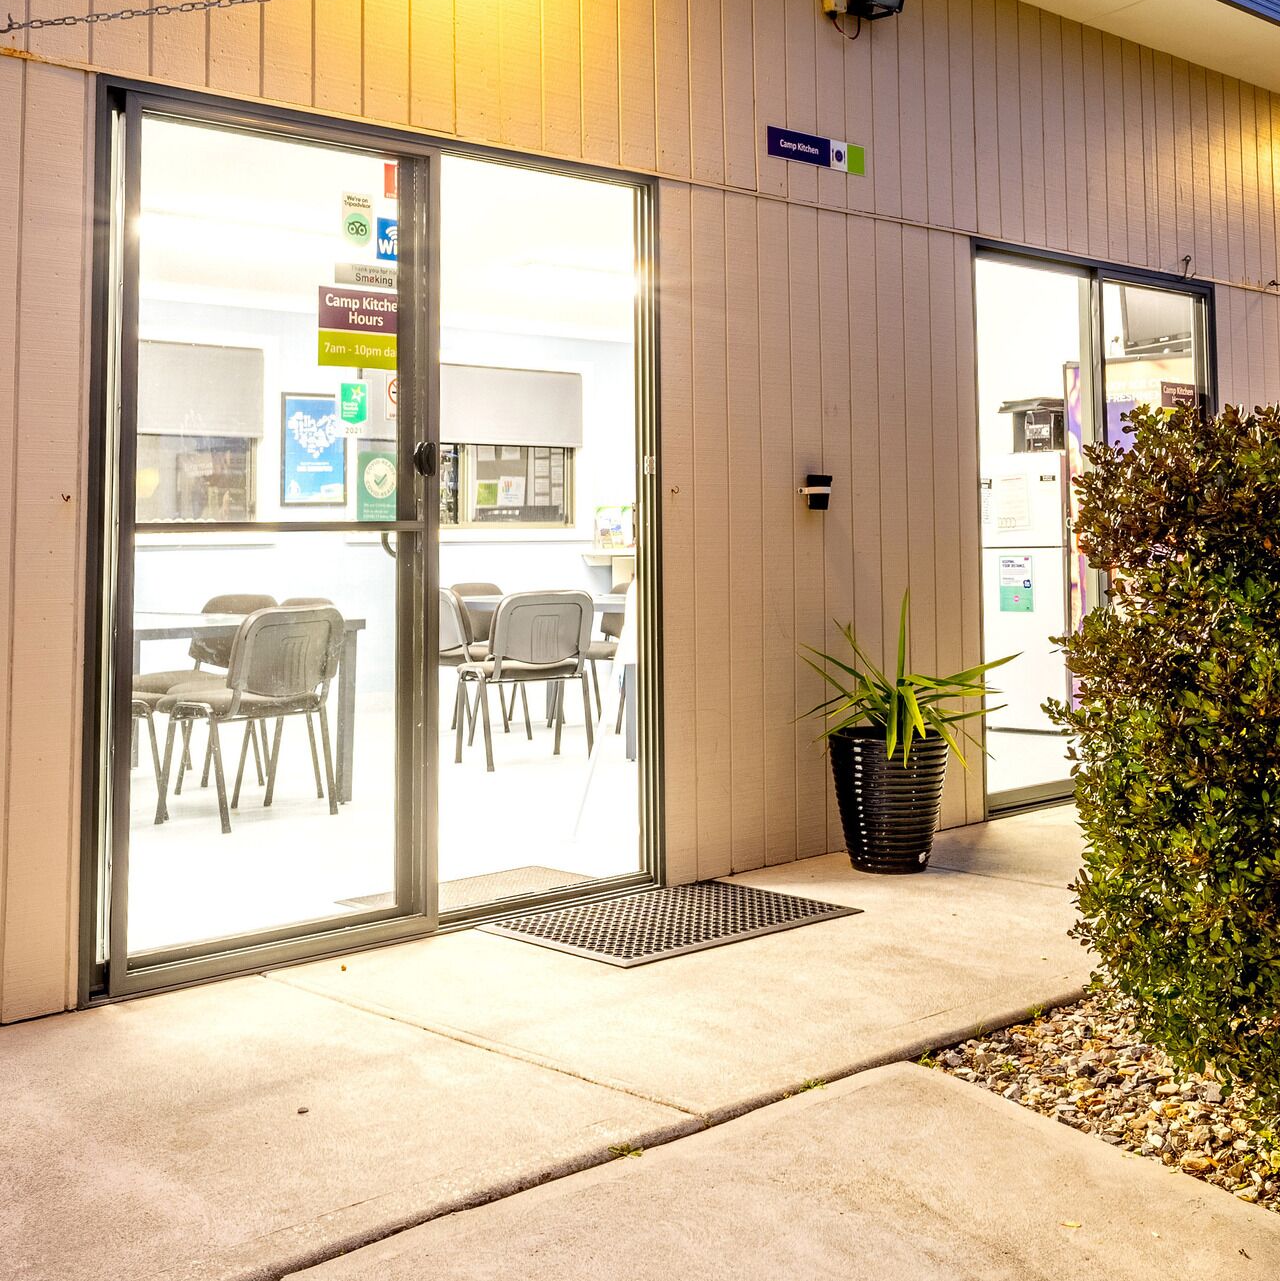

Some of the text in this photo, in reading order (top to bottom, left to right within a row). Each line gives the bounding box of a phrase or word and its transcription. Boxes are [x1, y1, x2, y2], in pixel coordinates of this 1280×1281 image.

[780, 139, 819, 155] Camp Kitchen
[378, 238, 398, 256] Wi
[355, 272, 393, 287] Smoking
[325, 293, 398, 313] Camp Kitche
[348, 311, 384, 327] Hours
[324, 342, 346, 354] 7am
[354, 344, 382, 358] 10pm
[383, 346, 398, 358] da
[1163, 385, 1194, 396] Camp Kitchen
[345, 426, 363, 434] 2021
